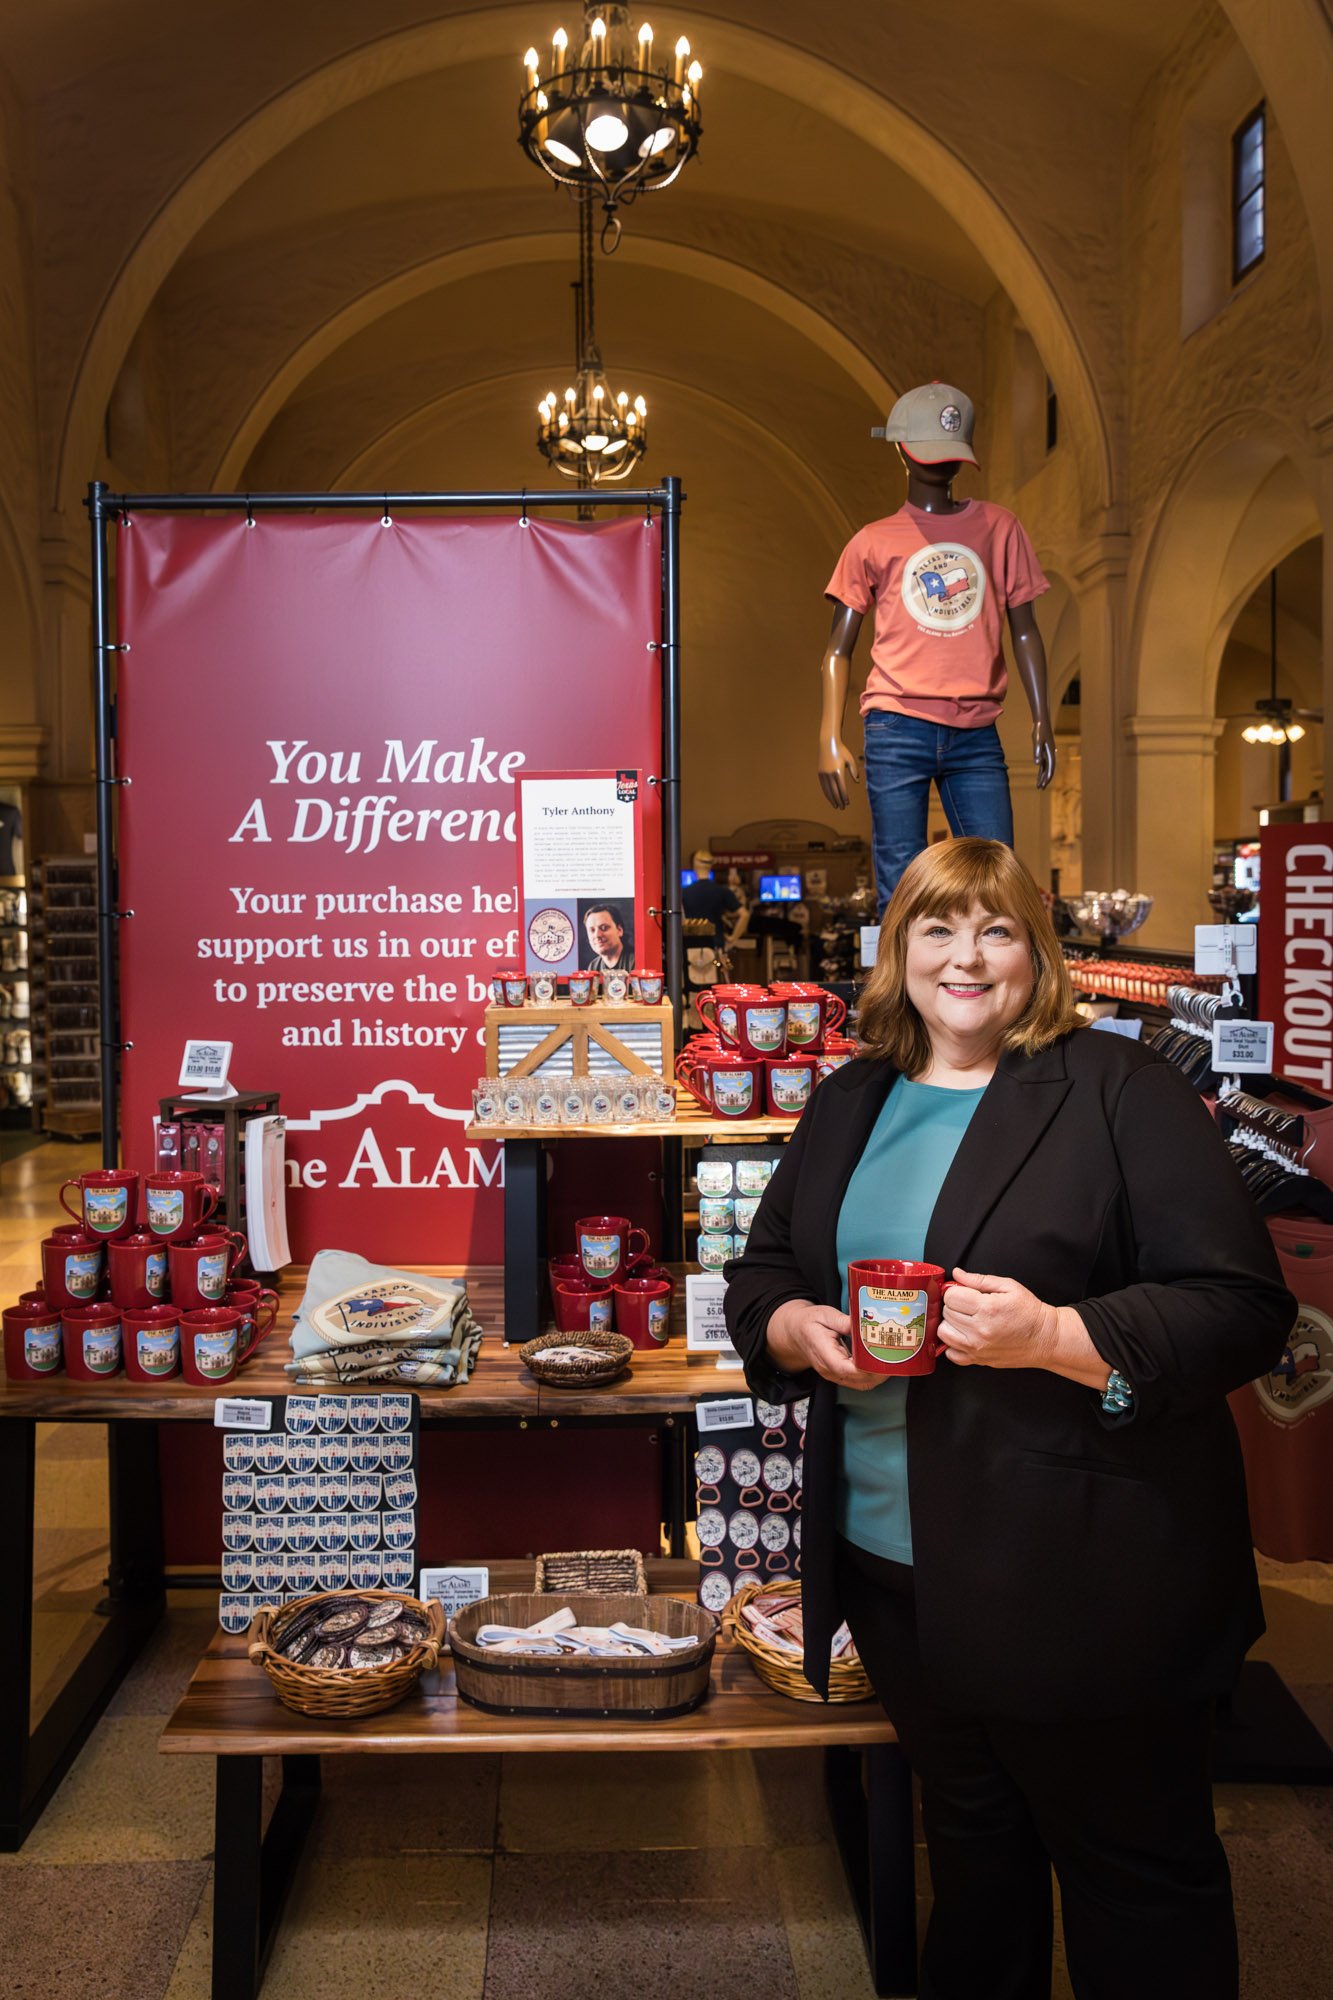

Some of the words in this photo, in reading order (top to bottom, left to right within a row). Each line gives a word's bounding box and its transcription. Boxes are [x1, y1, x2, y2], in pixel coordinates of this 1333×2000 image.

[266, 741, 361, 784] You
[376, 735, 526, 785] Make
[228, 798, 272, 843] A
[542, 807, 568, 817] Tyler
[571, 806, 615, 817] Anthony
[230, 887, 306, 914] Your
[316, 885, 463, 921] purchase
[198, 934, 324, 965] support
[332, 937, 369, 958] us
[378, 929, 412, 958] in
[420, 937, 478, 958] our
[486, 929, 519, 958] ef
[1283, 844, 1333, 1091] CHECKOUT
[214, 978, 248, 1003] to
[257, 982, 395, 1009] preserve
[404, 974, 458, 1003] the
[282, 1018, 343, 1047] and
[352, 1018, 468, 1054] history
[338, 1127, 505, 1188] ALAM
[871, 1288, 885, 1296] THE
